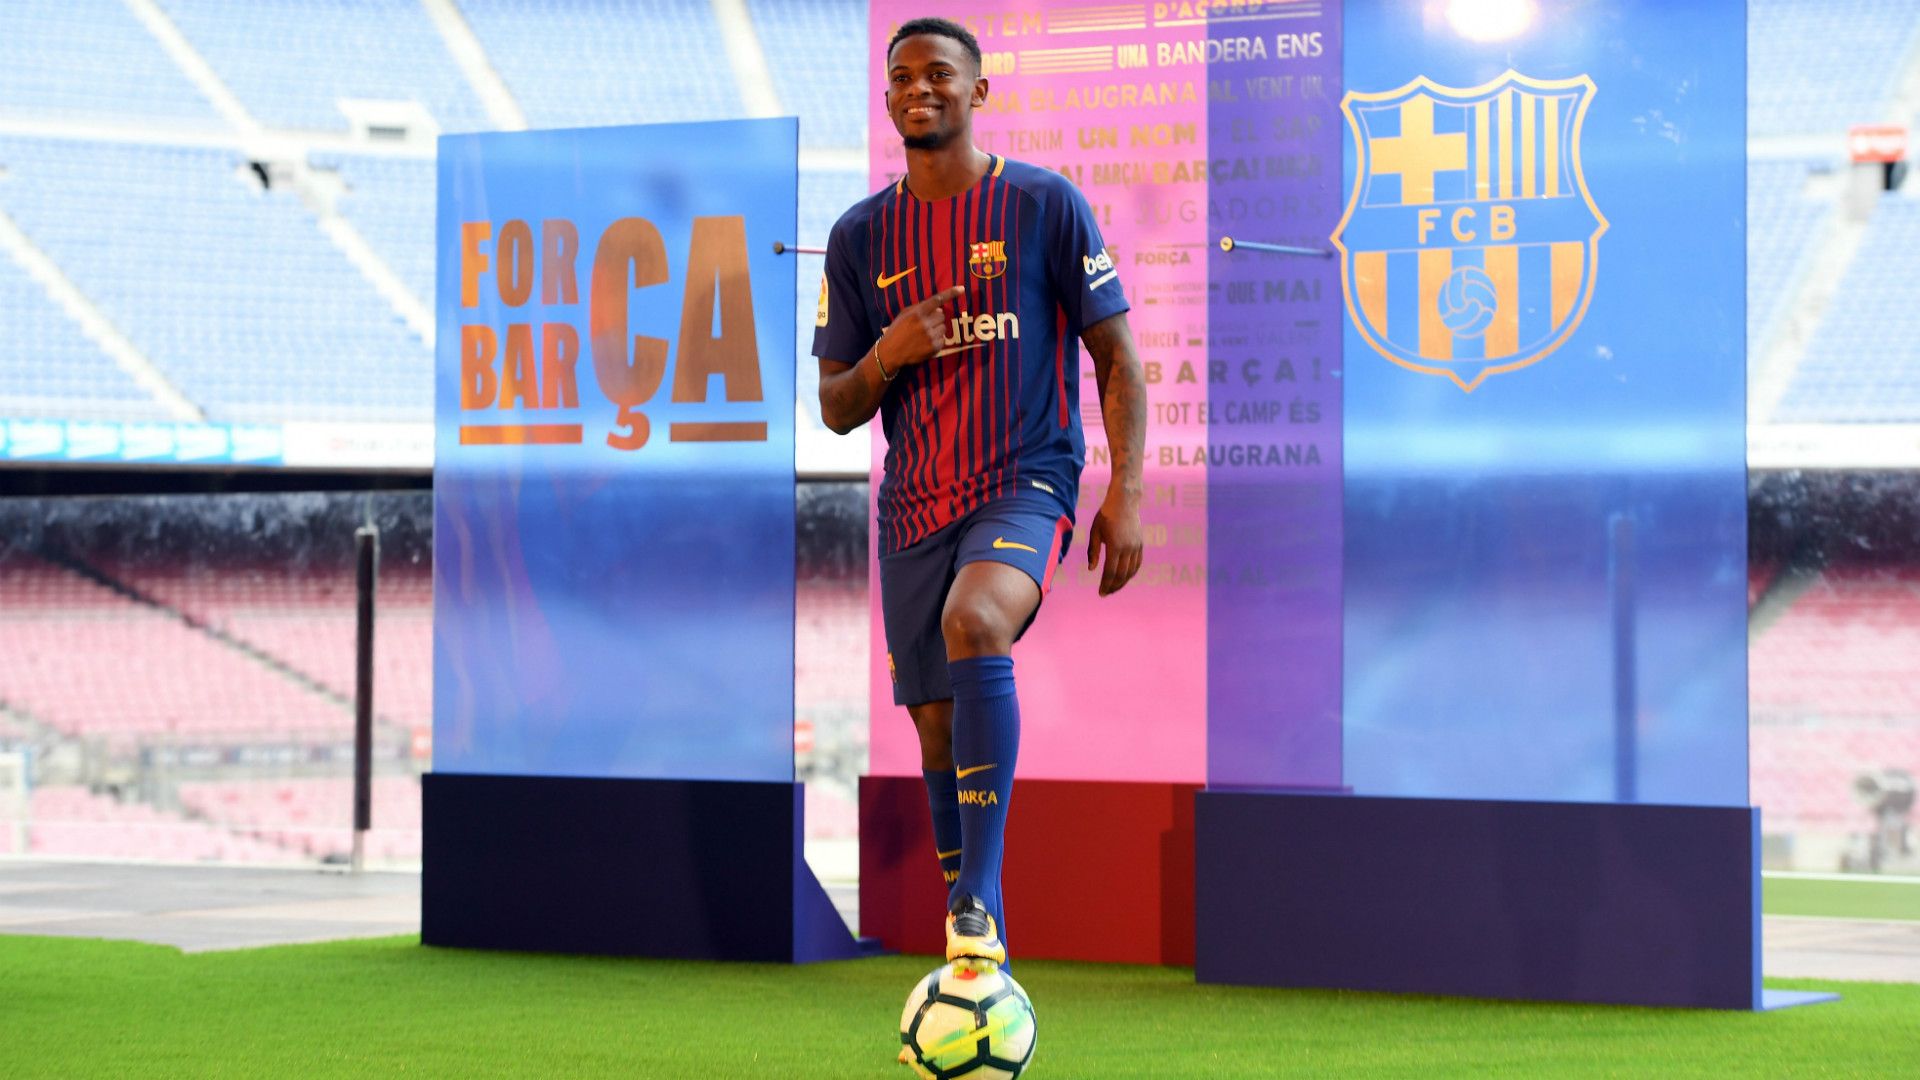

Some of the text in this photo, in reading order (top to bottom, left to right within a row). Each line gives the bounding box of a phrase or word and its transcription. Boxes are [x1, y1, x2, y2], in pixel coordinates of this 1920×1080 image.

[1117, 32, 1323, 68] UNA BANDERA ENS
[1029, 81, 1198, 112] BLAUGRANA
[1245, 75, 1294, 100] VENT
[1008, 128, 1063, 153] TENIM
[1077, 125, 1119, 150] UN
[1130, 121, 1197, 147] NOM
[1136, 194, 1325, 226] JUGADORS
[1417, 204, 1517, 245] FCB
[460, 218, 580, 308] FOR
[1135, 250, 1191, 268] FORÇA
[1263, 277, 1322, 305] MAI
[460, 322, 580, 411] BAR
[1156, 402, 1191, 425] TOT
[1198, 401, 1218, 425] EL
[1225, 400, 1281, 425] CAMP
[1158, 444, 1322, 467] BLAUGRANA
